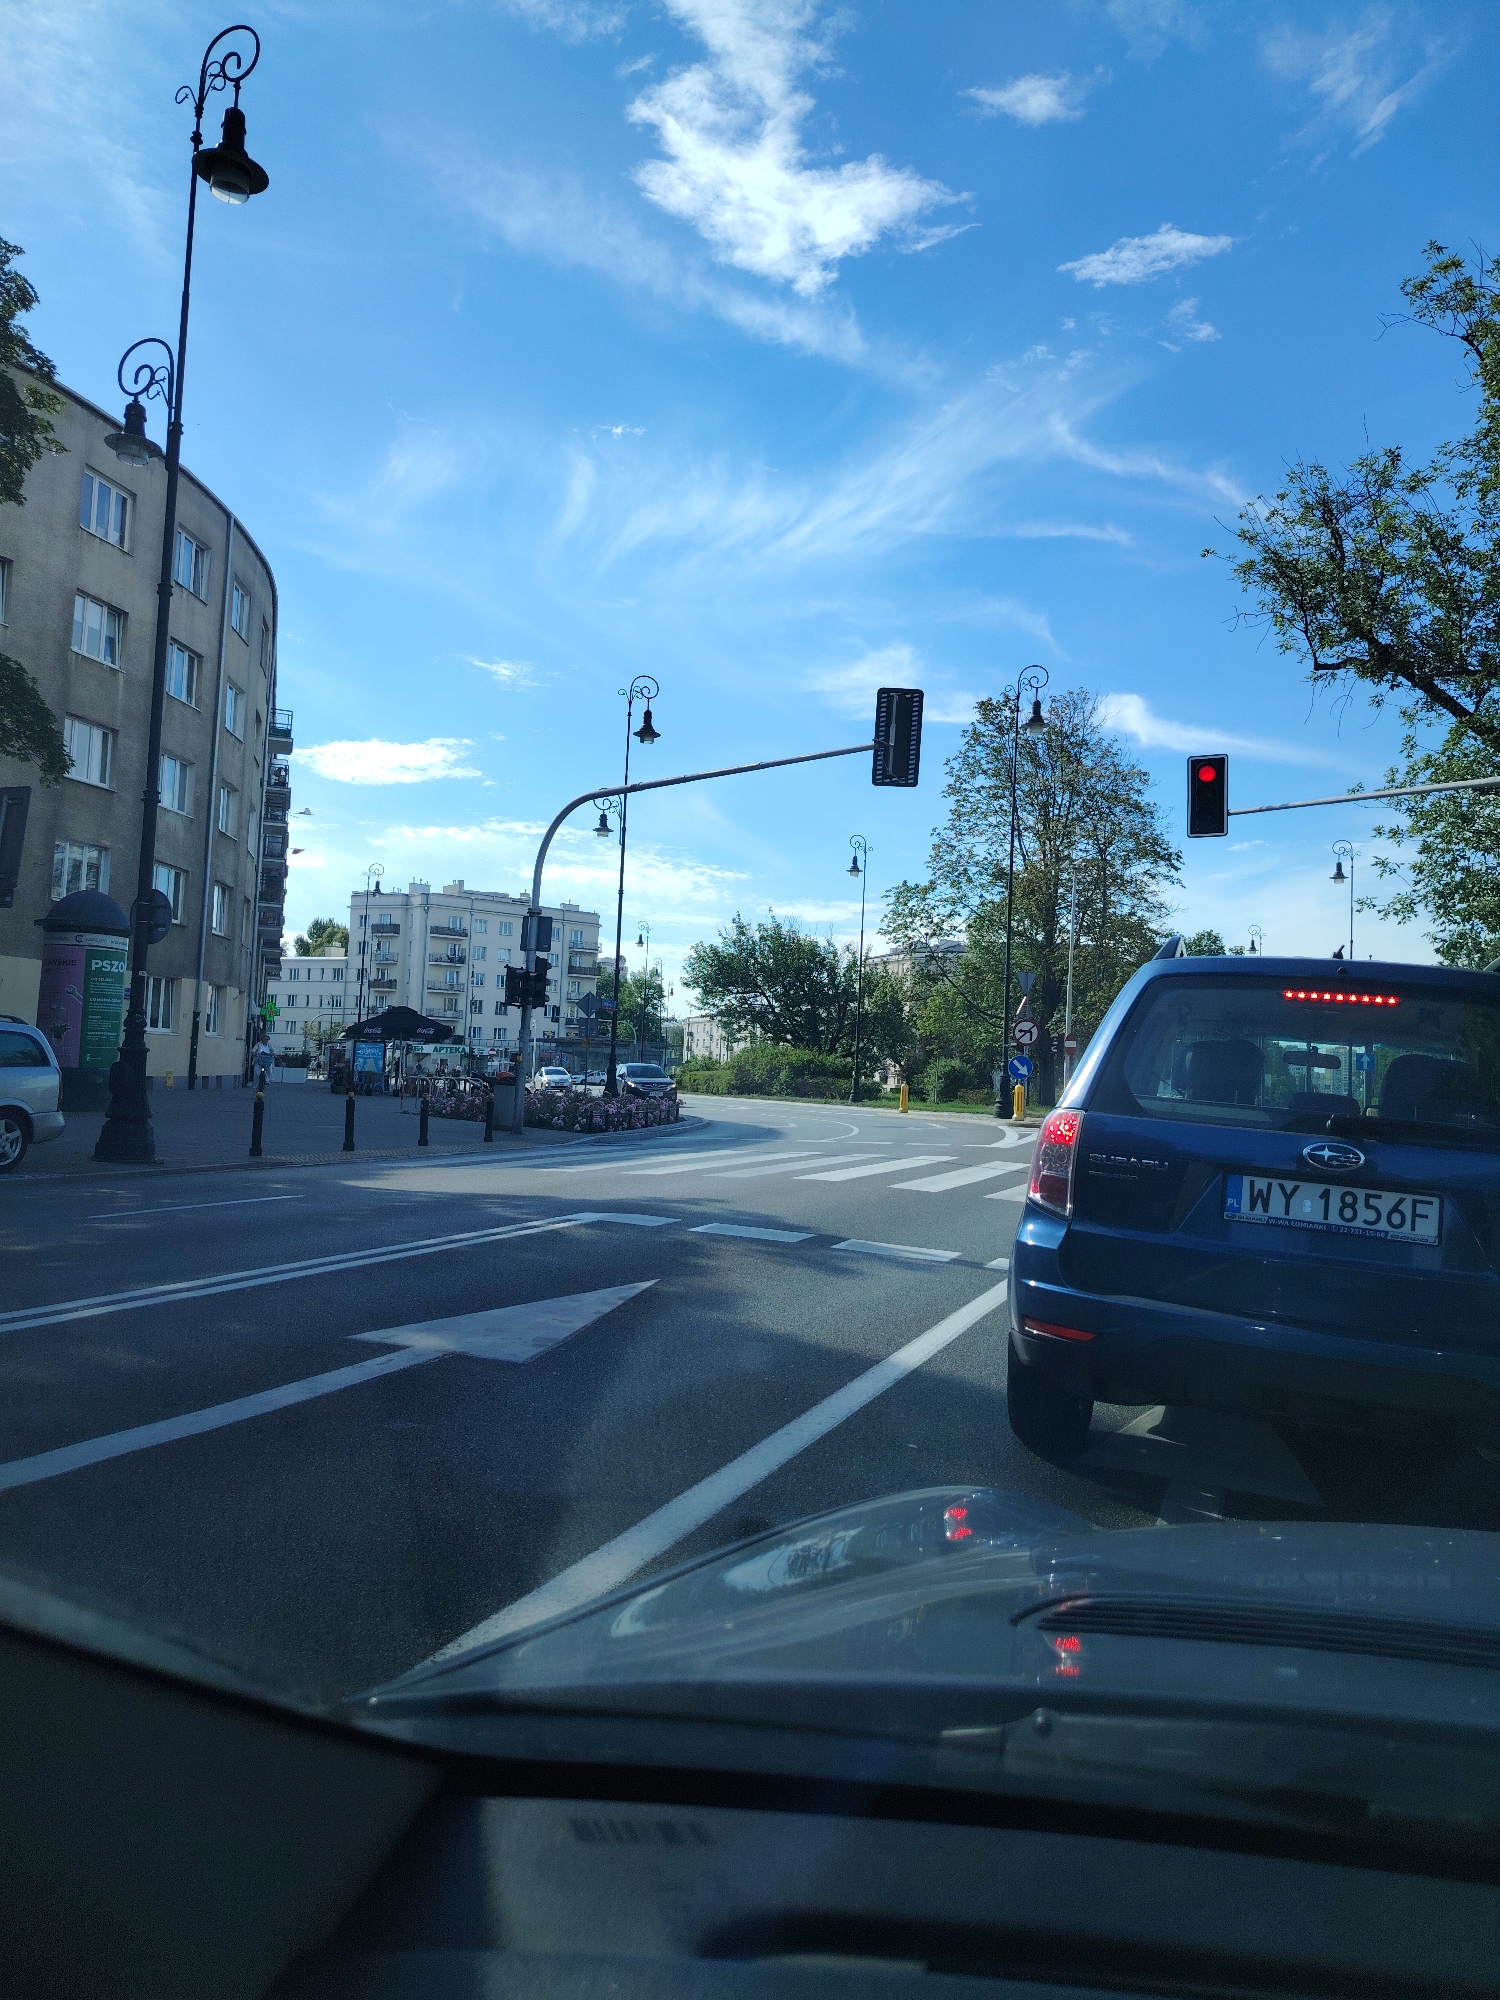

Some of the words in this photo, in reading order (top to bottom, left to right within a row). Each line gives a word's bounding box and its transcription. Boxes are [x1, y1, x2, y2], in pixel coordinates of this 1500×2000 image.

[433, 1045, 467, 1054] APTEKA
[1088, 1152, 1170, 1172] SUBARU
[1227, 1197, 1240, 1208] PL
[1249, 1179, 1301, 1216] WY
[1318, 1188, 1434, 1232] 1856F
[1268, 1218, 1290, 1227] W-WA
[1290, 1221, 1327, 1231] ŁOMIANKI
